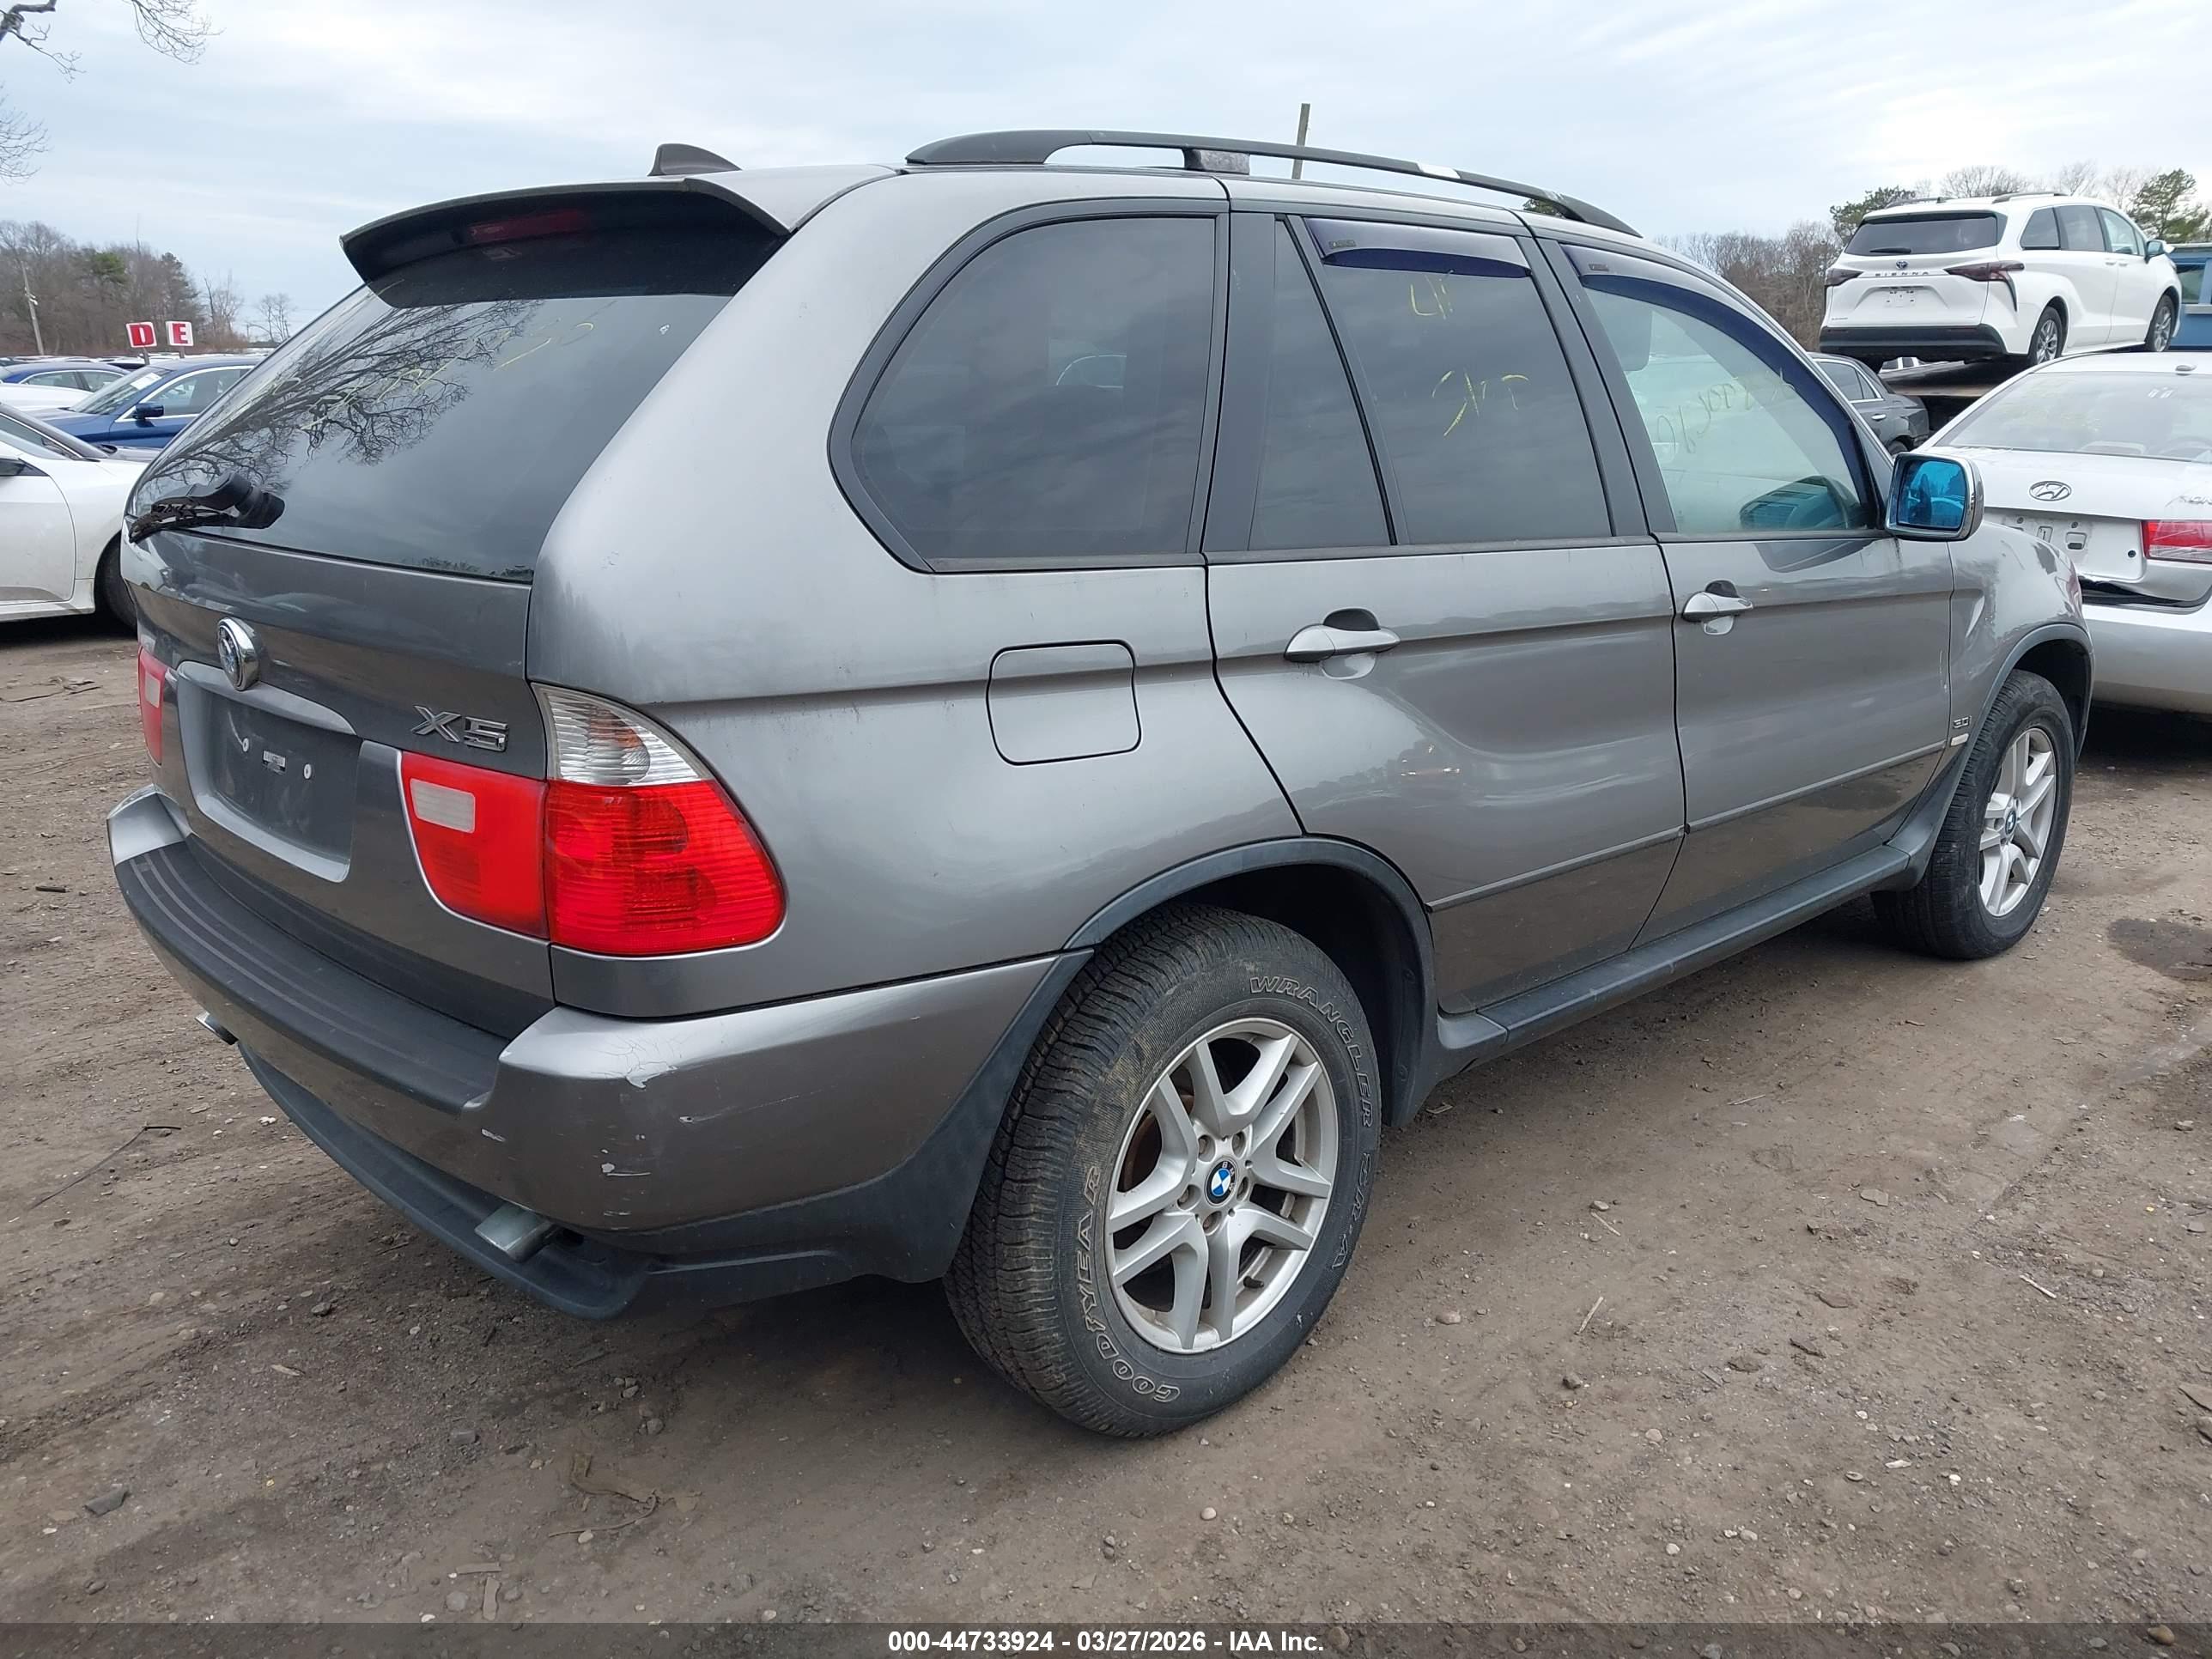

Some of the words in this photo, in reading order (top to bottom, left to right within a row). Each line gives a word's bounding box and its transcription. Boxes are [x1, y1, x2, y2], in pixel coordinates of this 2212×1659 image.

[129, 324, 155, 346] D
[172, 323, 188, 344] E
[410, 705, 508, 752] X5
[1249, 976, 1373, 1128] WRANGLER
[1078, 1165, 1181, 1402] GOODYEAR
